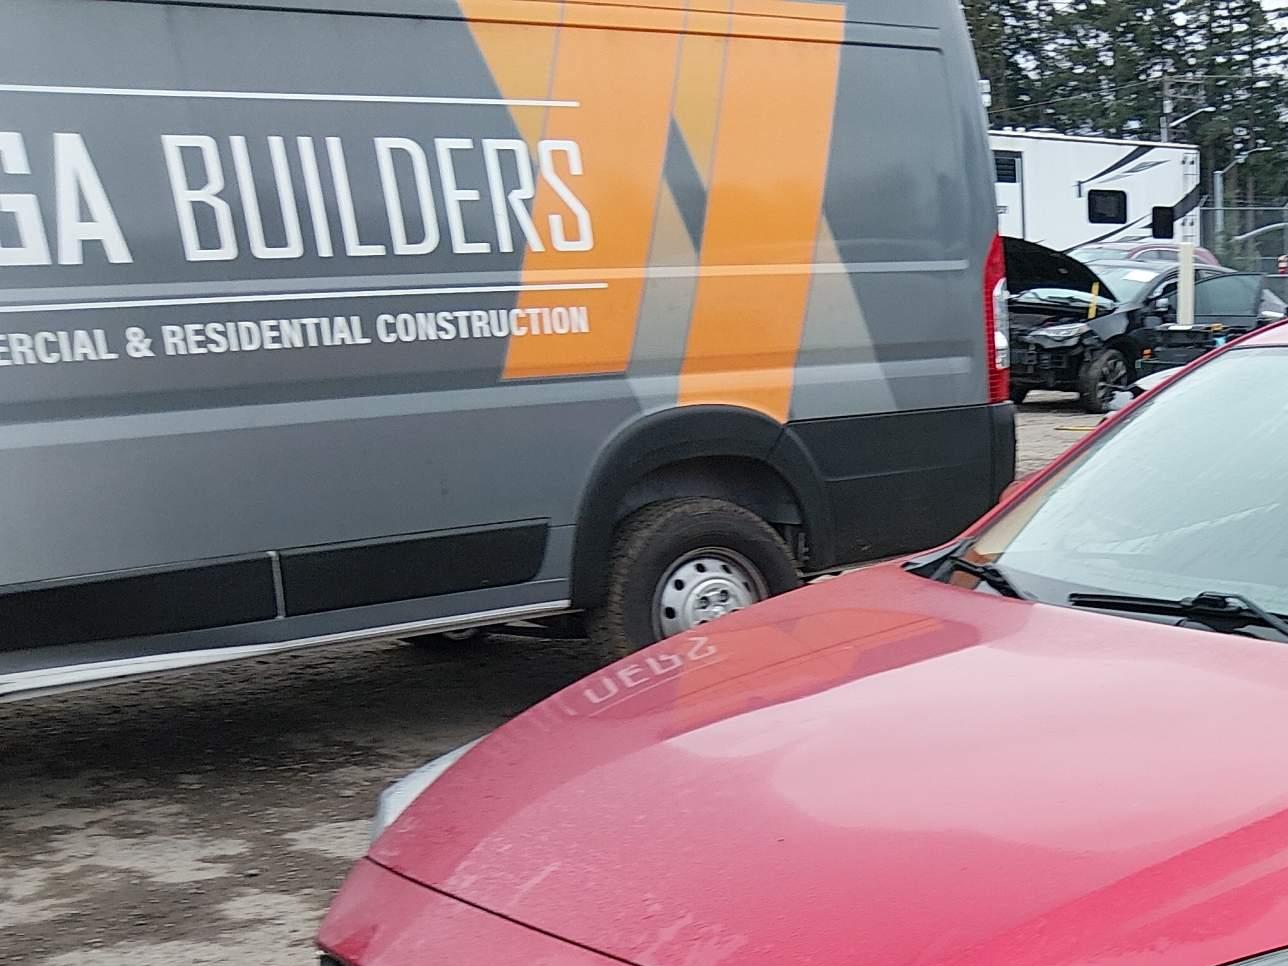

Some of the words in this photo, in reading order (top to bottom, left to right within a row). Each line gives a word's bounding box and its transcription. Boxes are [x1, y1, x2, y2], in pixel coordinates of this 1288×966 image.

[161, 135, 594, 262] BUILDERS
[125, 326, 156, 357] &
[161, 315, 372, 356] RESIDENTIAL
[376, 306, 590, 343] CONSTRUCTION
